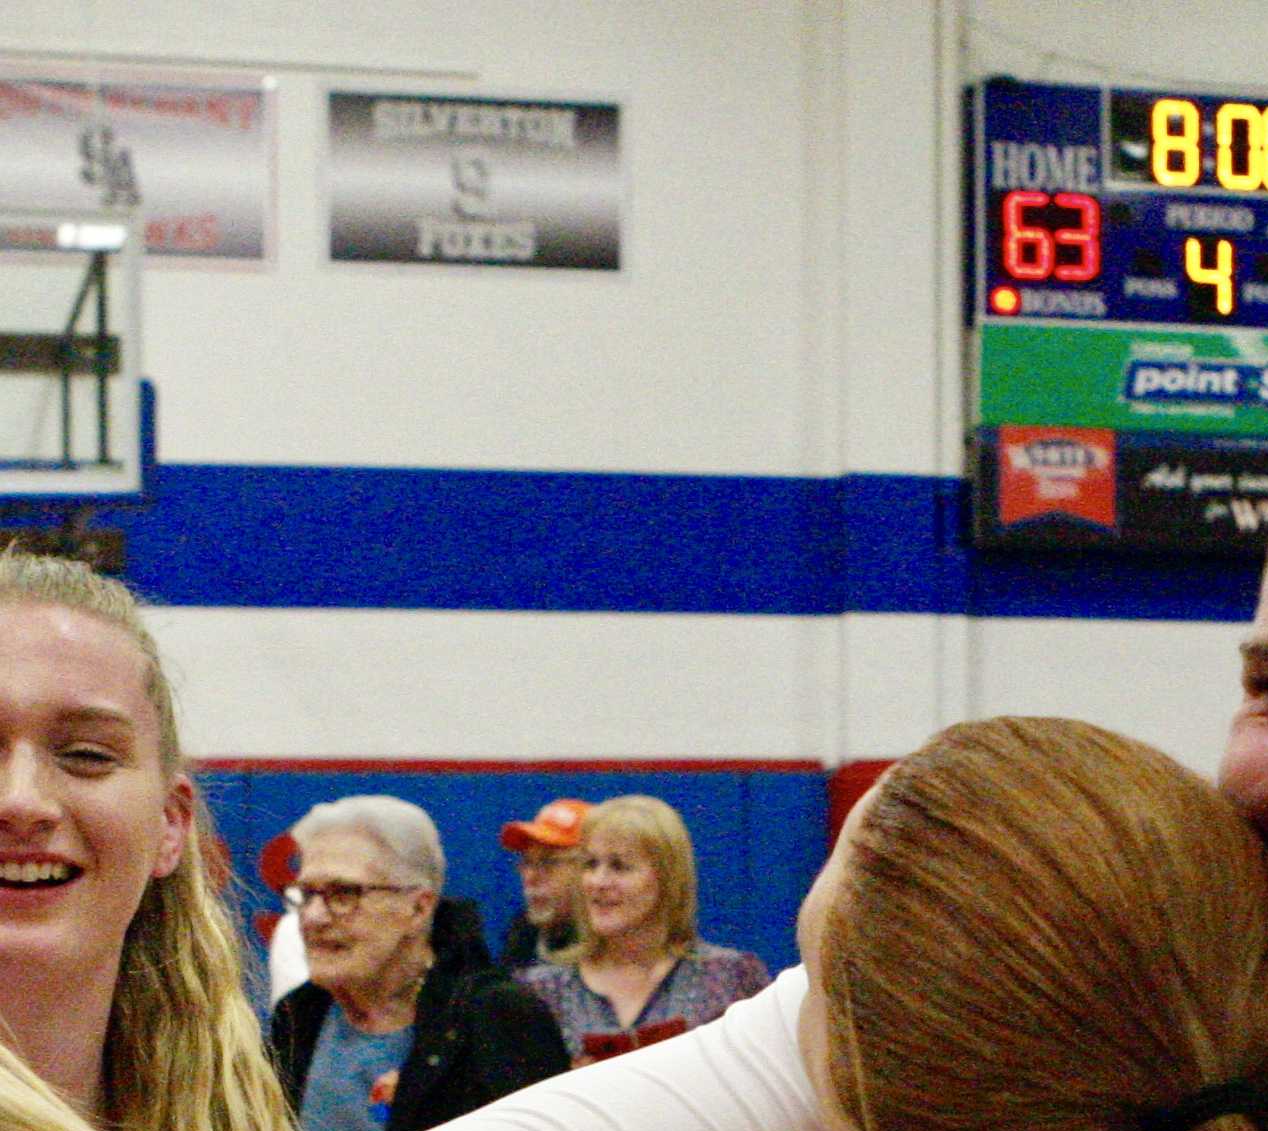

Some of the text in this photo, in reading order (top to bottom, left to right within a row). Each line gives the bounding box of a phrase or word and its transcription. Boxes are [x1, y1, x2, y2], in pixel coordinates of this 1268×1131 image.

[374, 102, 574, 146] SILVERTON
[992, 141, 1099, 191] HOME
[1003, 191, 1101, 282] 63
[1185, 237, 1233, 316] 4
[1133, 364, 1239, 396] point
